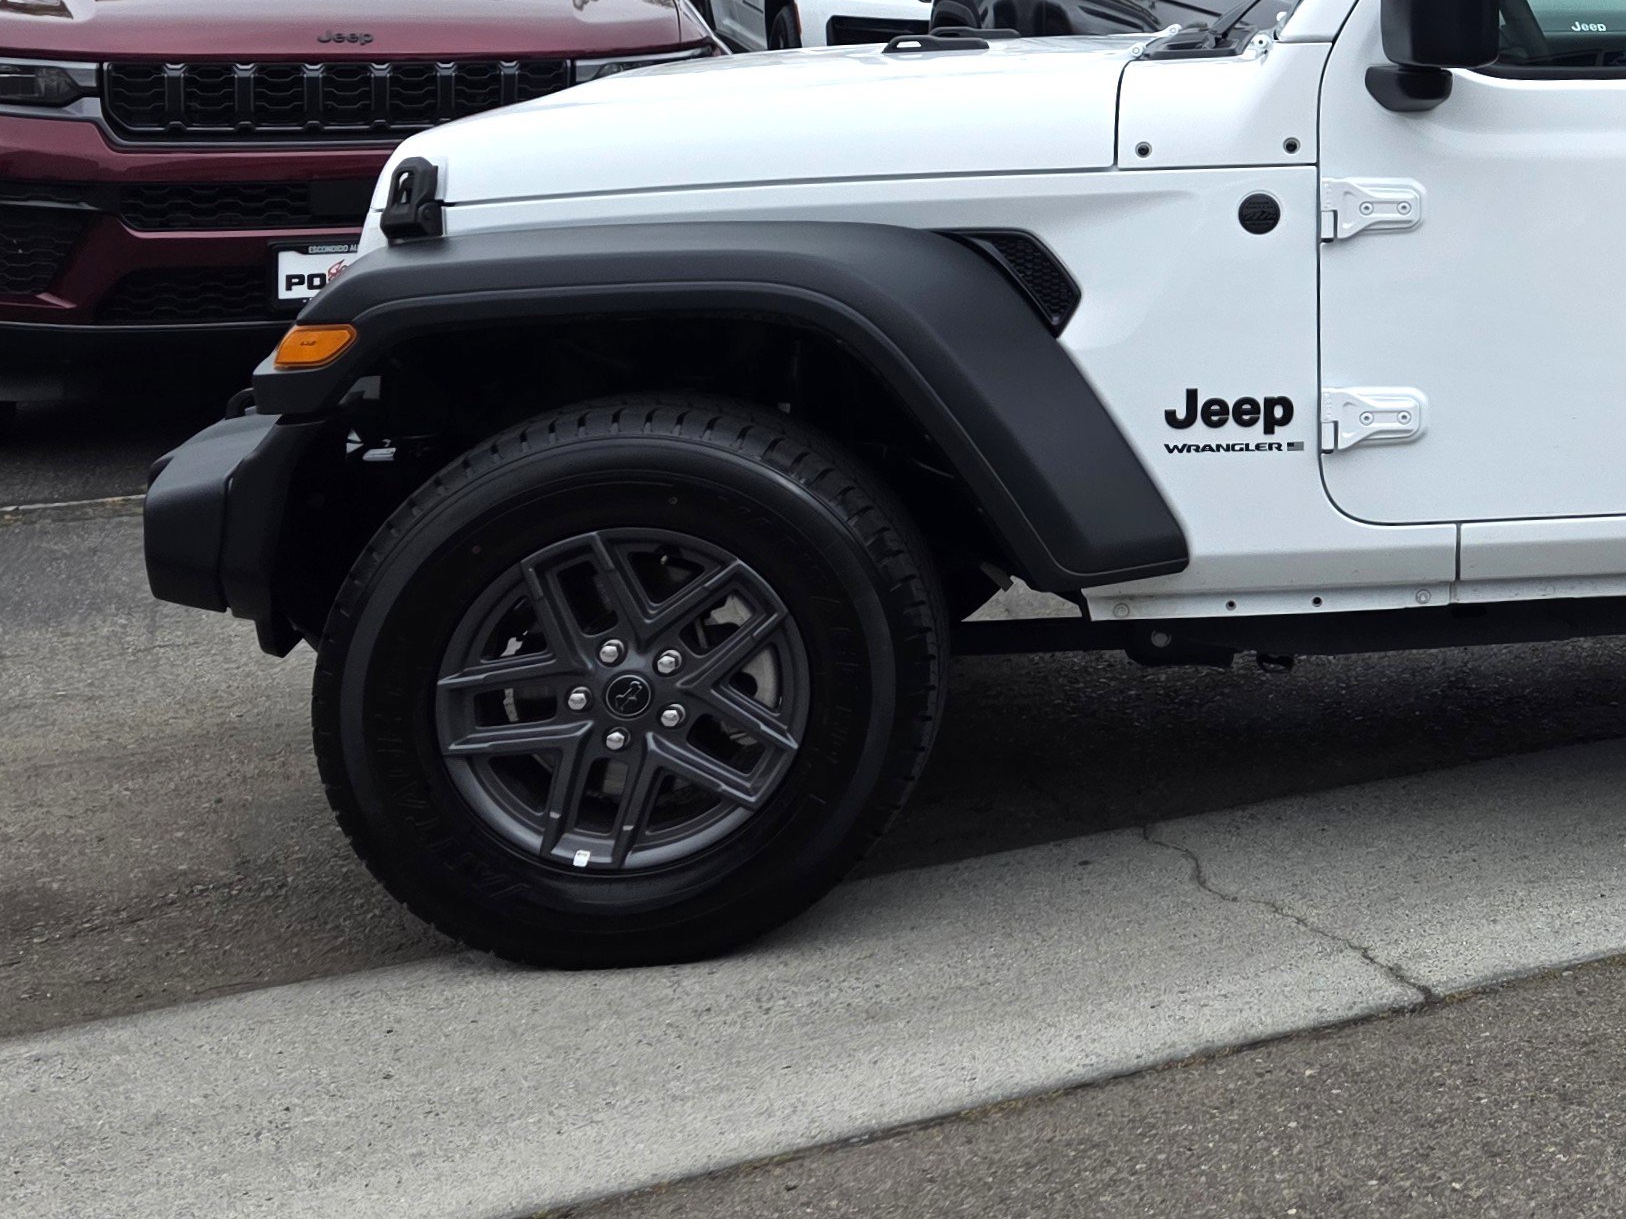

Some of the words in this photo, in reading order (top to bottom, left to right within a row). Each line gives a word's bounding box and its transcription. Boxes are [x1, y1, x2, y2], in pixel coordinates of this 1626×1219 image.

[1571, 21, 1607, 32] Jeep
[316, 29, 374, 46] Jeep
[1164, 387, 1294, 435] Jeep
[1163, 441, 1283, 454] WRANGLER
